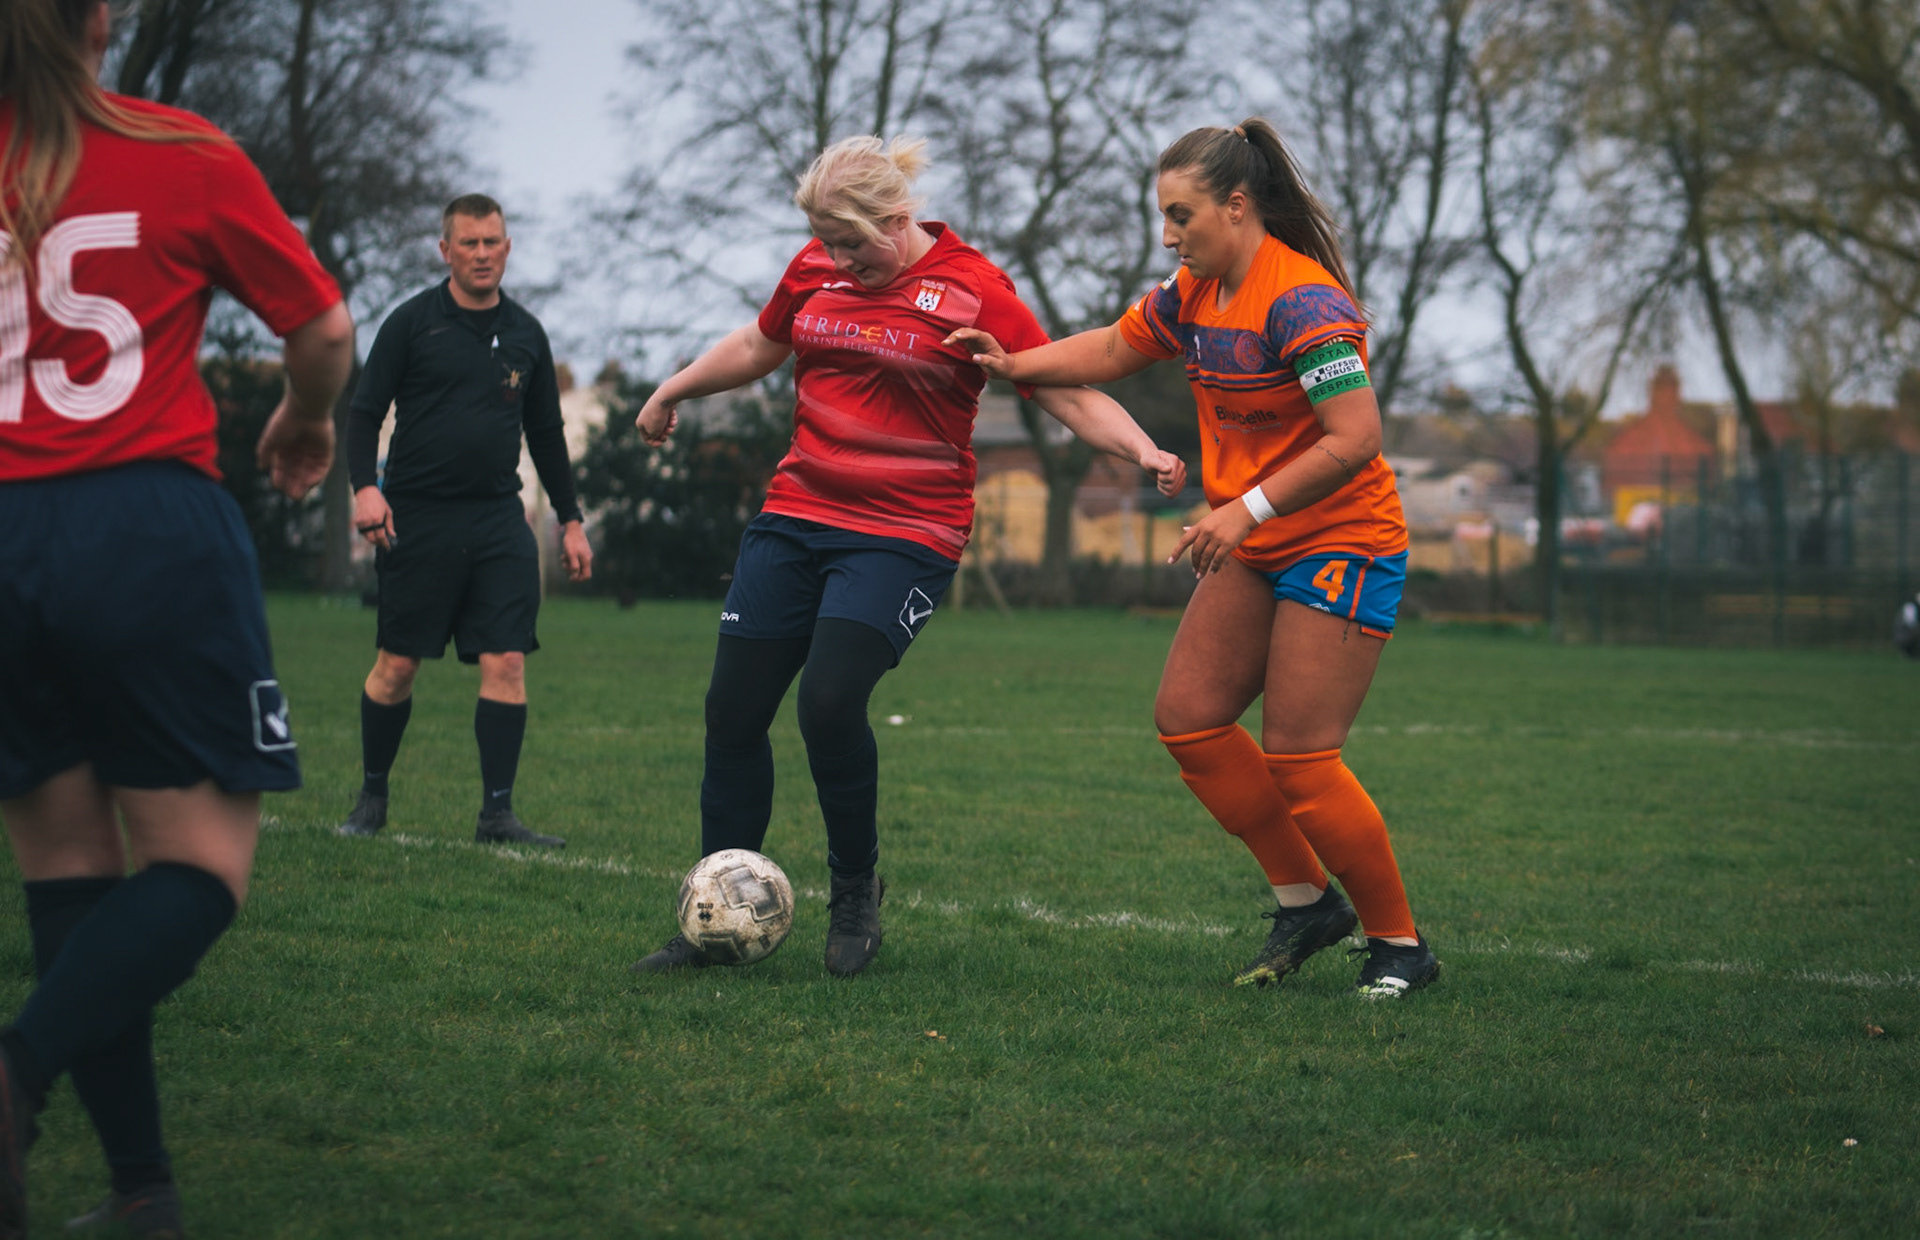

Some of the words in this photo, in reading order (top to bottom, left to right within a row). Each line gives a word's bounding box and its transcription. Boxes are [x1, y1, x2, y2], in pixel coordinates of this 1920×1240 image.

[802, 314, 920, 350] TRIDENT
[798, 333, 839, 347] MARINE
[843, 340, 914, 362] ELECTRICAL
[1325, 358, 1360, 372] OFFSIDE
[1325, 364, 1357, 378] TRUST
[1312, 374, 1367, 400] RESPECT
[1311, 559, 1350, 603] 4
